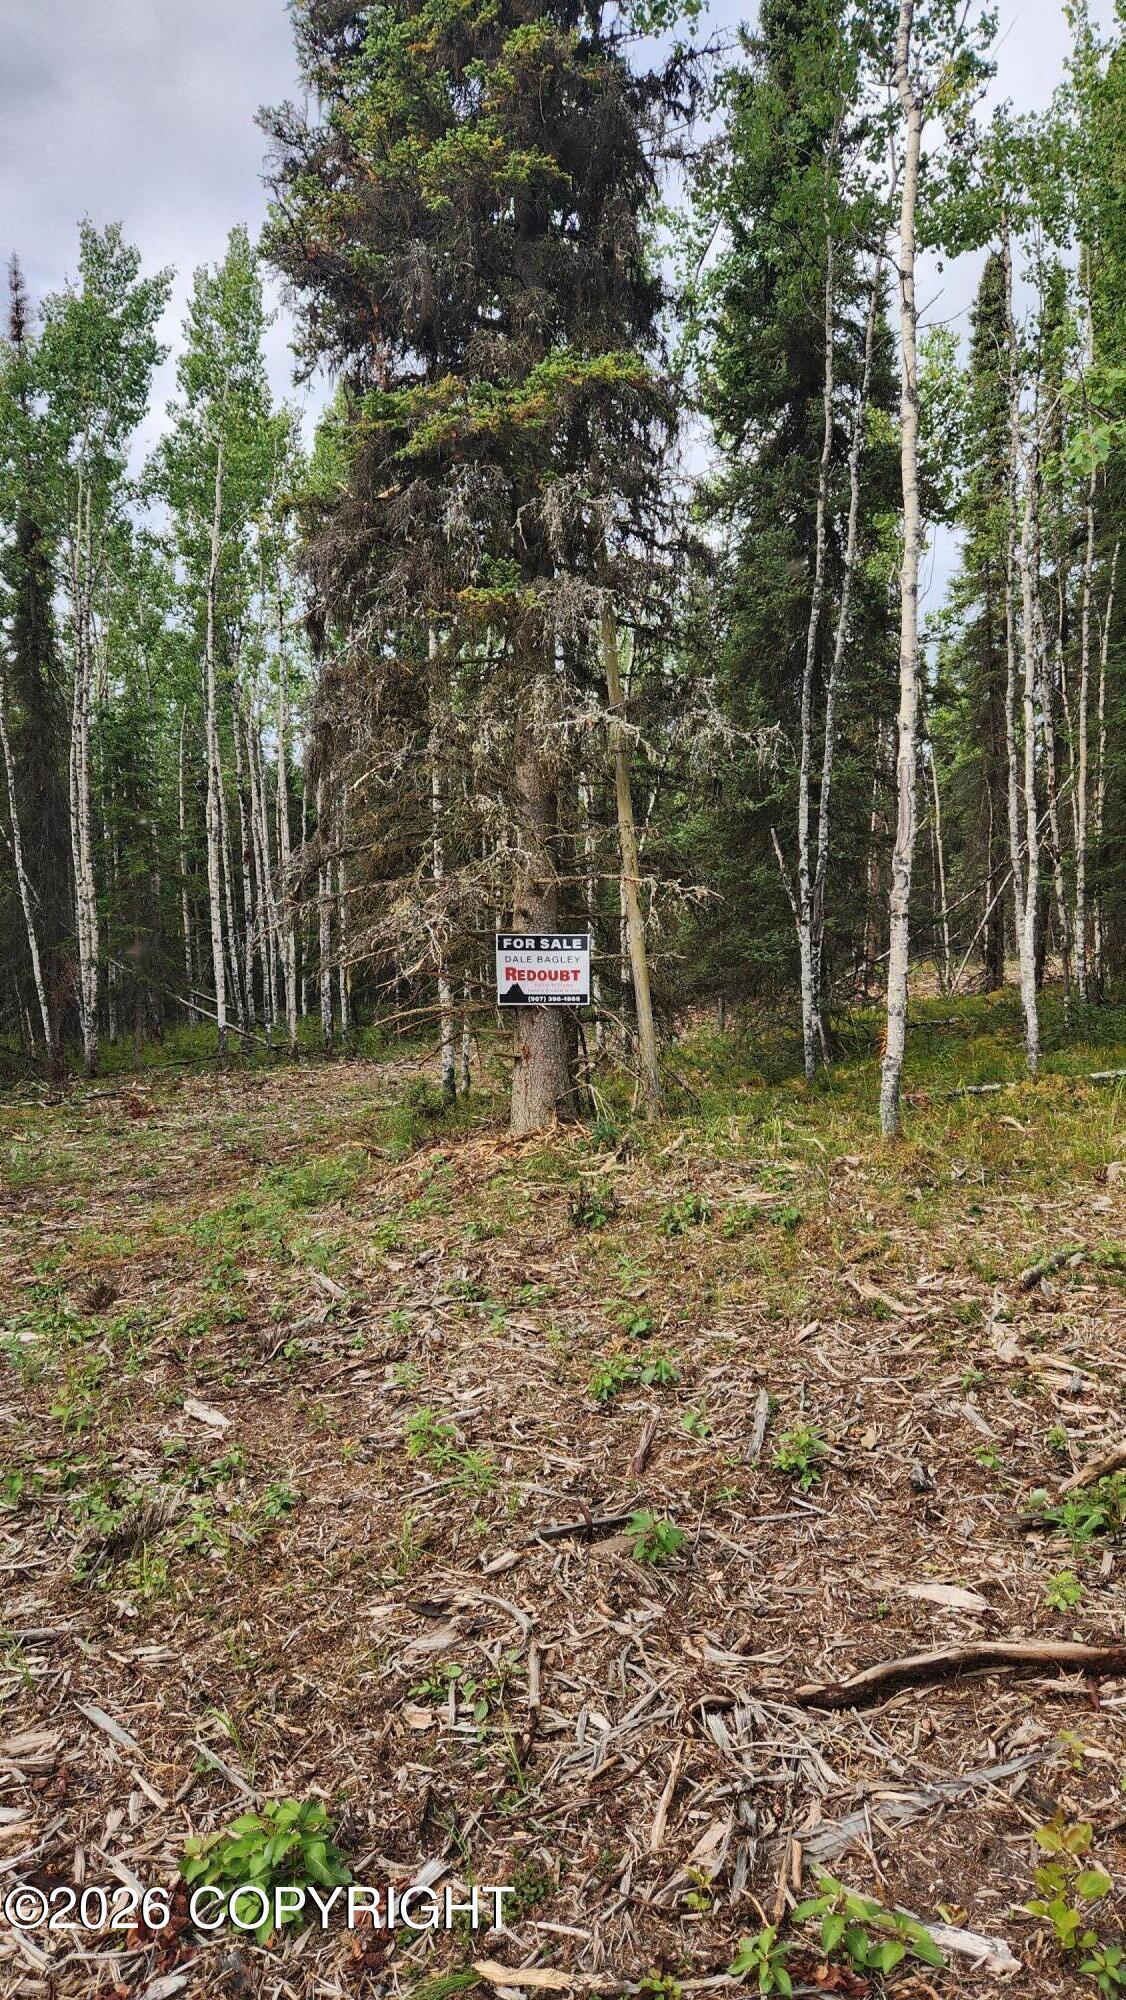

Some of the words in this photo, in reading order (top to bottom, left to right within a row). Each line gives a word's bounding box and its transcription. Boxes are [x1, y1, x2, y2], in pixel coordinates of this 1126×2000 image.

[503, 938, 535, 949] FOR
[540, 938, 582, 949] SALE
[504, 955, 533, 963] DALE
[536, 955, 581, 964] BAGLEY
